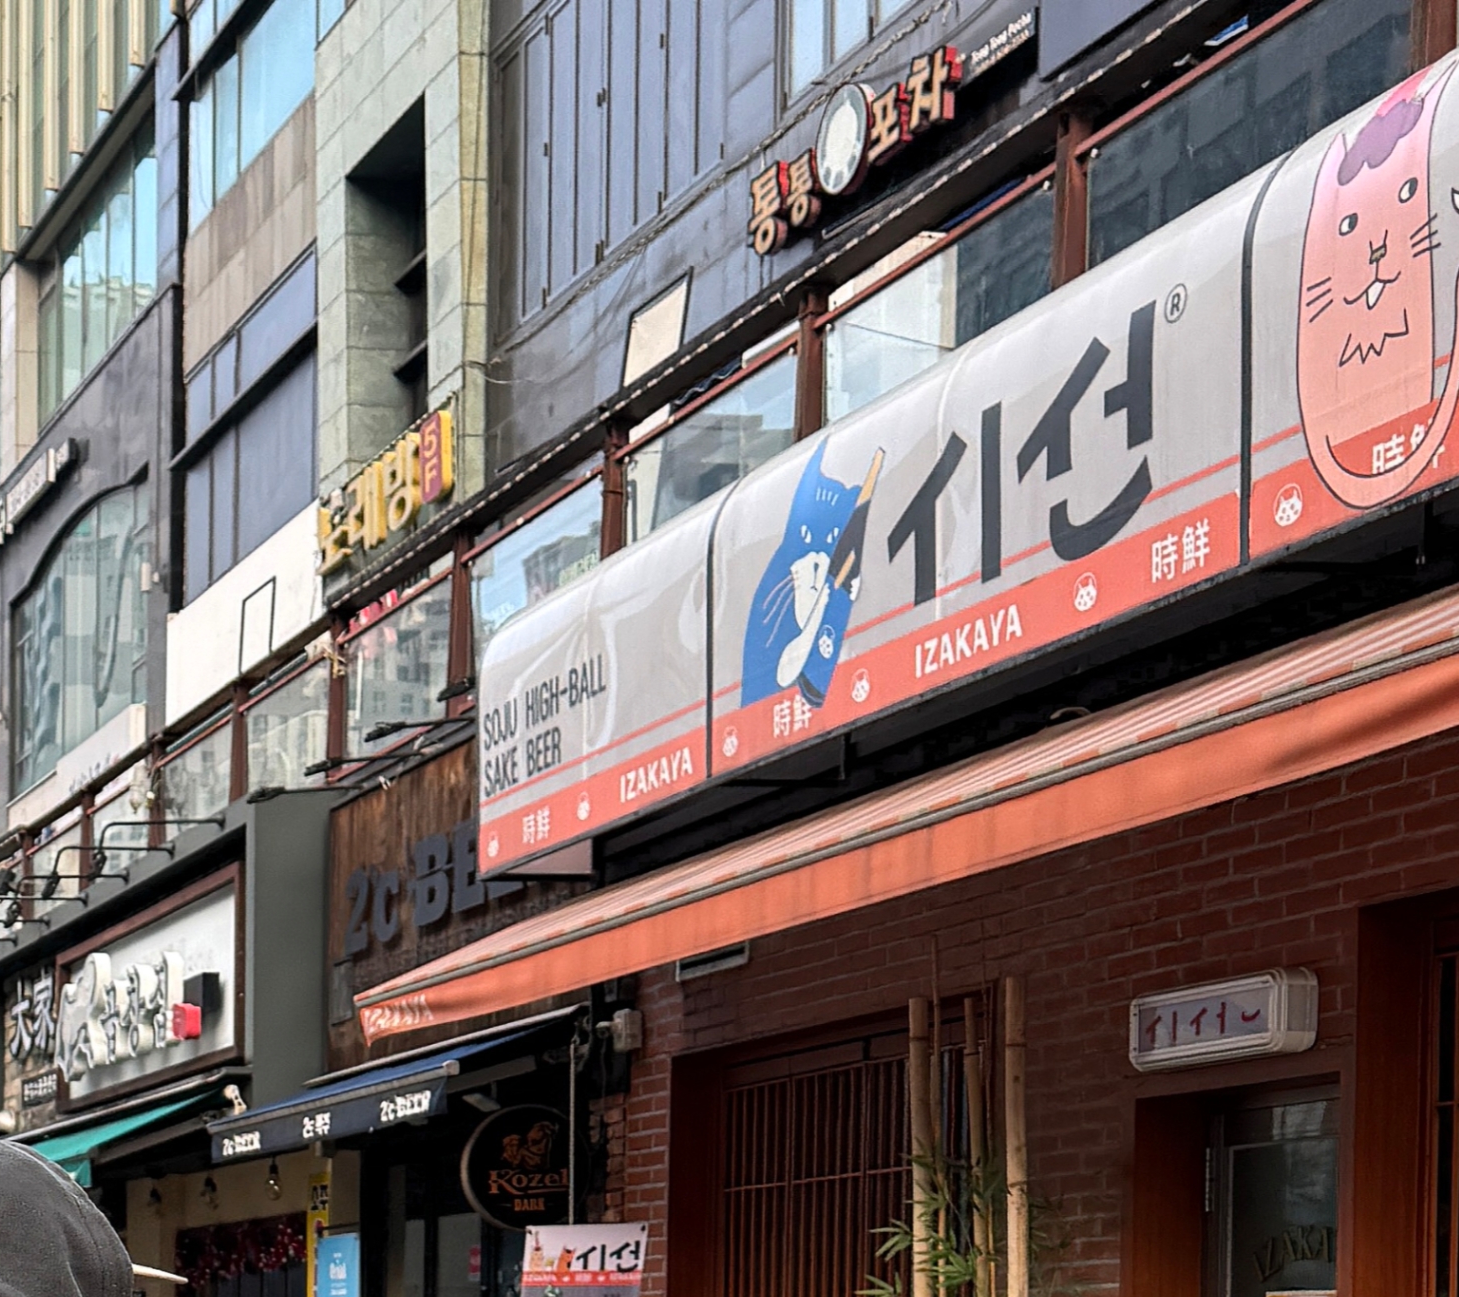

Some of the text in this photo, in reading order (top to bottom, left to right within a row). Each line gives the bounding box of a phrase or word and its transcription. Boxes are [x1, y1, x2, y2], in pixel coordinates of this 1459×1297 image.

[748, 46, 946, 256] 통통 포차
[887, 299, 1158, 607] 시선
[1151, 518, 1210, 583] 時鮮
[914, 605, 1023, 678] IZAKAYA
[484, 653, 607, 751] SOJU HIGH-BALL
[484, 726, 562, 798] SAKE BEER
[620, 746, 694, 803] IZAKAYA
[488, 1167, 571, 1195] Kozel
[514, 1198, 546, 1212] DARK
[575, 1240, 640, 1273] 시선
